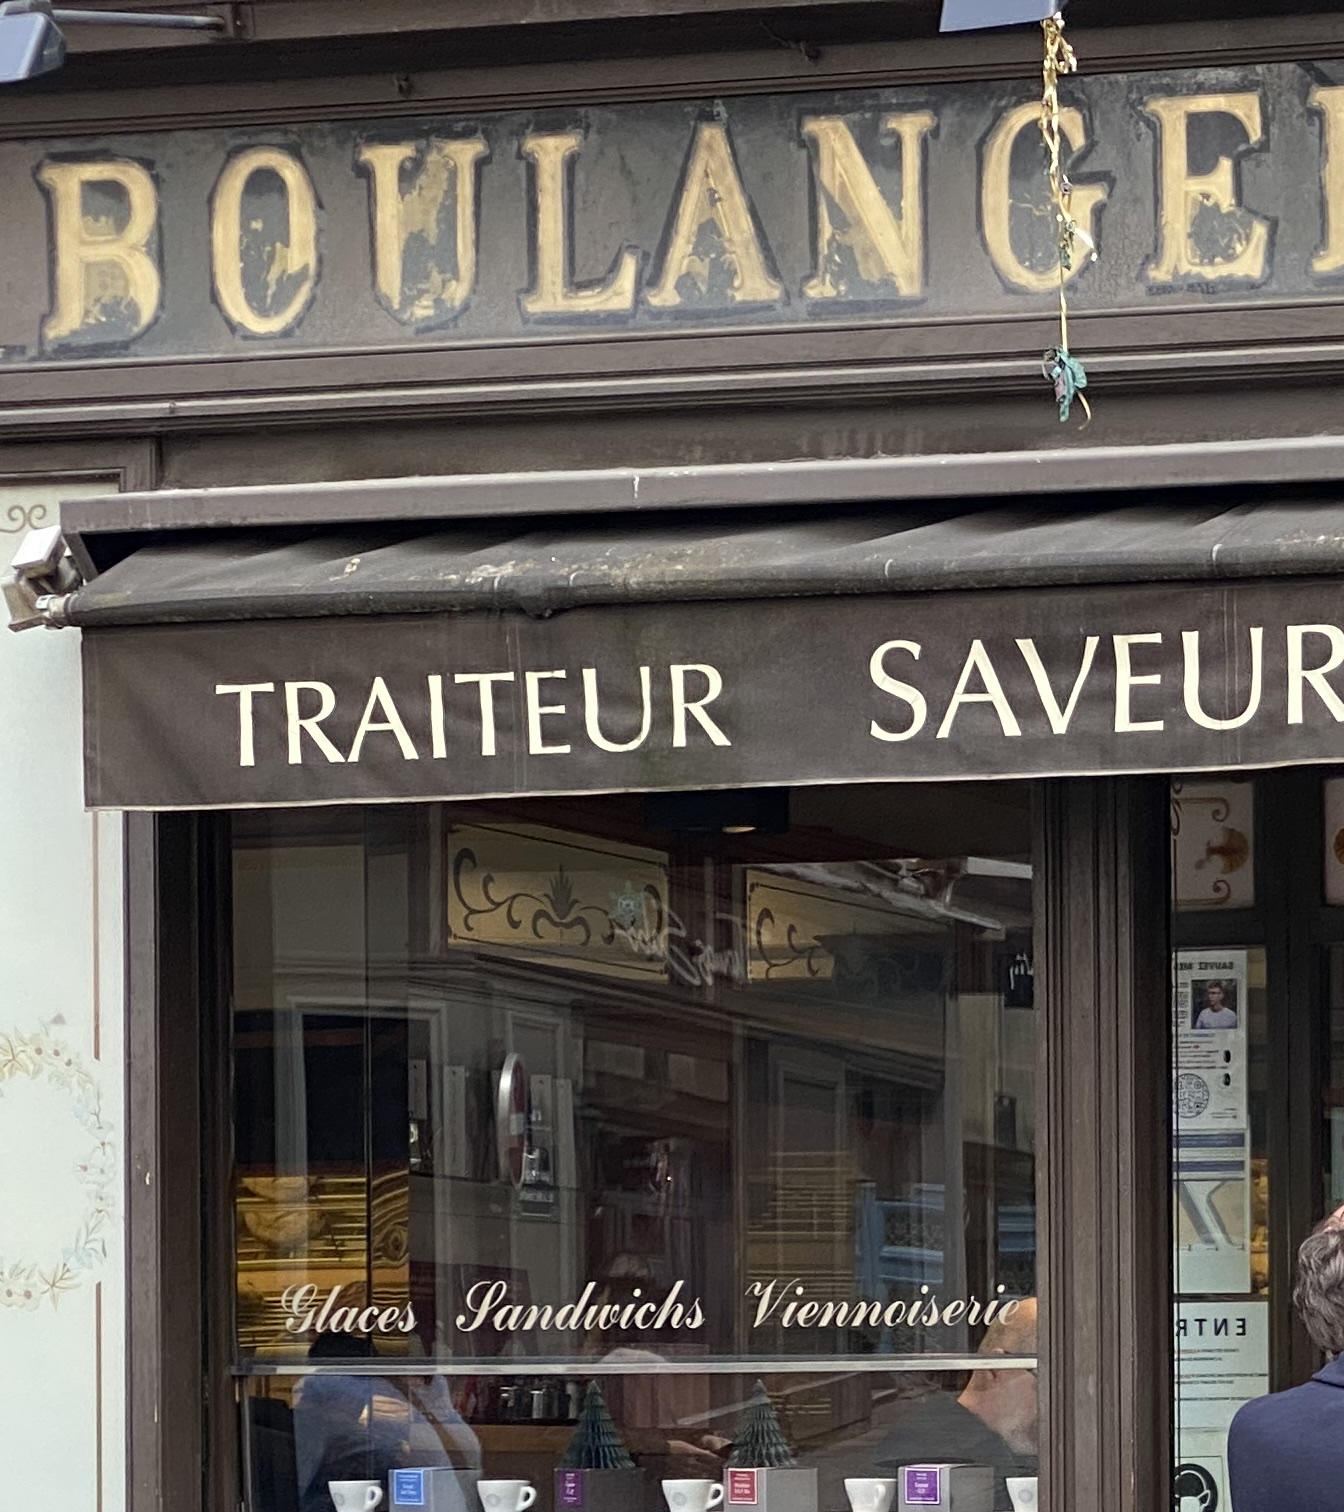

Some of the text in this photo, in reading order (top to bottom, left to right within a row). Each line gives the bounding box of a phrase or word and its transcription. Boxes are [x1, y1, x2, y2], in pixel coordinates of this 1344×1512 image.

[216, 662, 732, 767] TRAITEUR
[281, 1277, 1023, 1334] Glaces Sandwichs Viennoiserie
